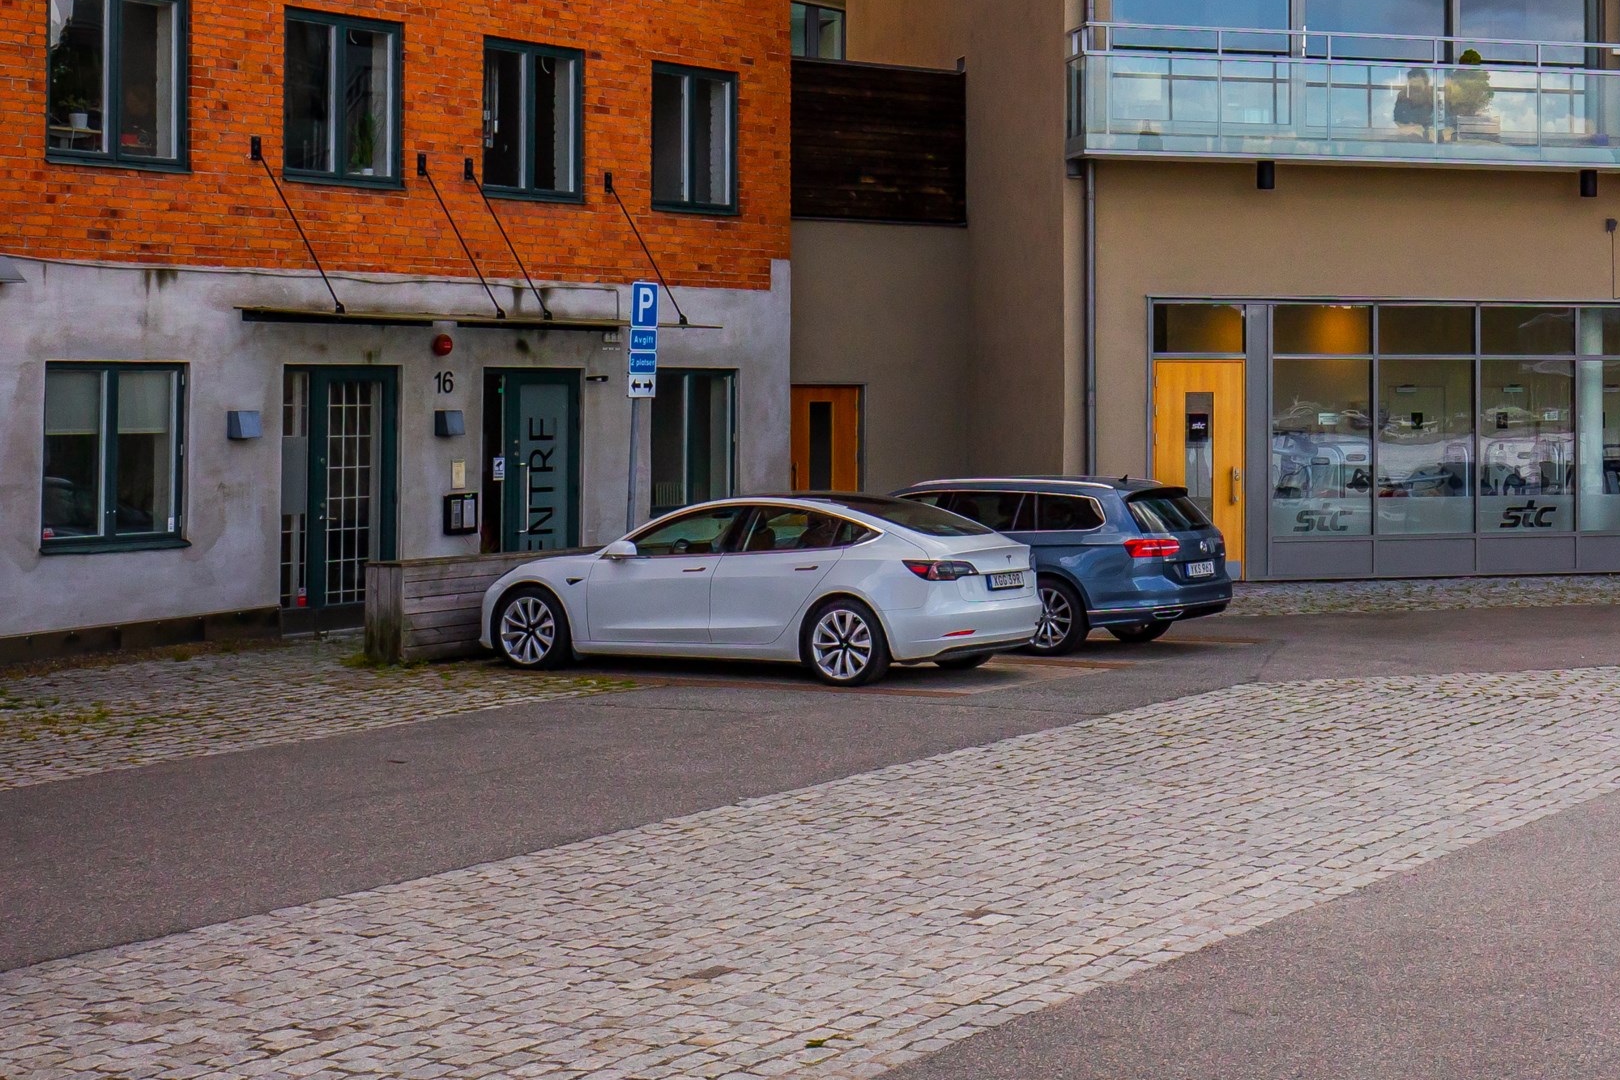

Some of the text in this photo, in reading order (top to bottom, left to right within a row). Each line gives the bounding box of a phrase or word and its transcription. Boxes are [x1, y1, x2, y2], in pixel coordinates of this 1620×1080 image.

[638, 287, 654, 322] P
[633, 336, 654, 346] Avgift
[636, 359, 655, 367] platser
[434, 371, 454, 394] 16
[1293, 503, 1353, 532] stc
[1499, 500, 1557, 528] stc
